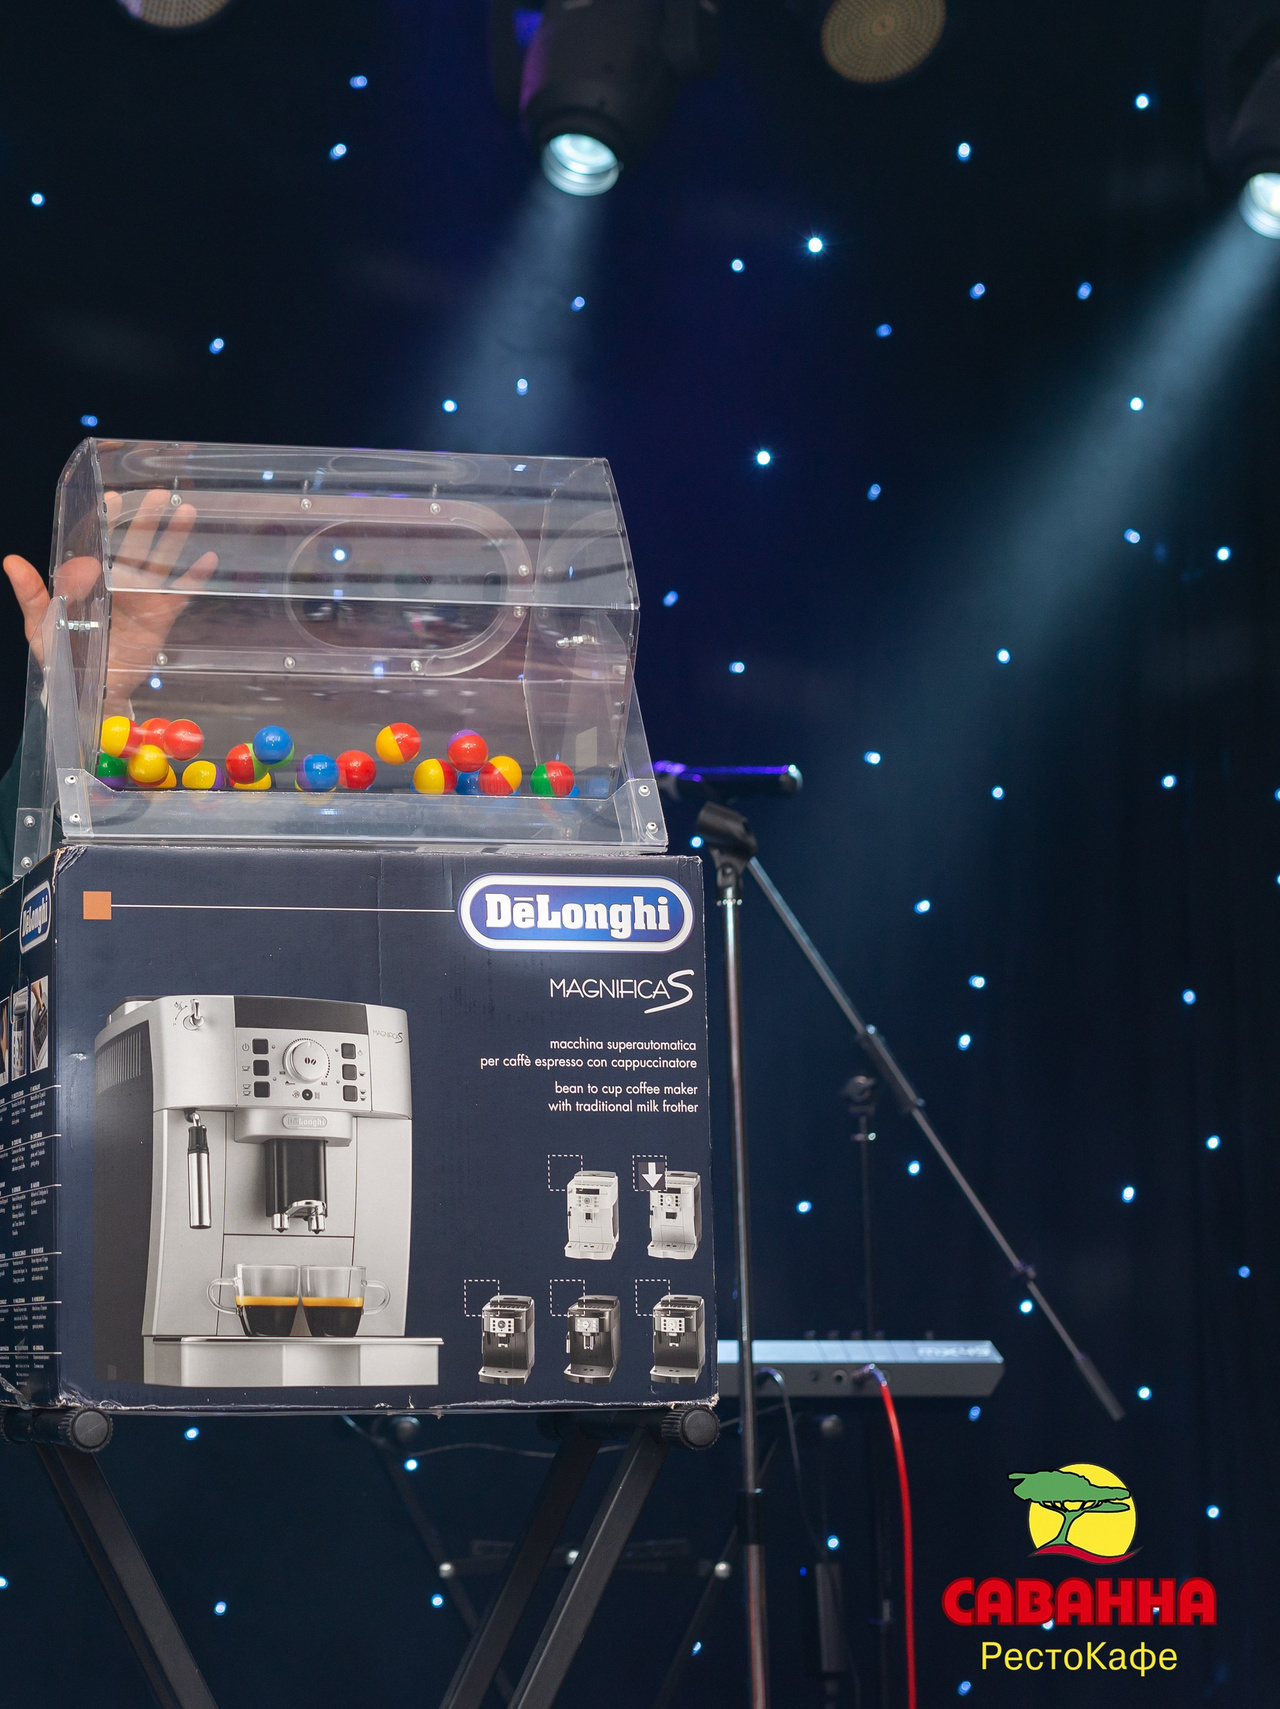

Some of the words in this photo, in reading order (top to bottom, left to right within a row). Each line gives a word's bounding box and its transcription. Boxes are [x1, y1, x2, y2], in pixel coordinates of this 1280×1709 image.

[549, 1036, 604, 1050] macchina
[606, 1039, 697, 1054] superautomatica
[480, 1056, 500, 1070] per
[502, 1053, 532, 1067] caffè
[534, 1057, 584, 1071] espresso
[586, 1057, 608, 1068] con
[610, 1056, 698, 1072] cappuccinatore
[554, 1080, 584, 1094] bean
[587, 1082, 599, 1094] to
[601, 1084, 623, 1098] cup
[625, 1080, 661, 1095] coffee
[663, 1081, 699, 1095] maker
[547, 1098, 572, 1112] with
[575, 1098, 633, 1113] traditional
[636, 1099, 660, 1113] milk
[662, 1099, 699, 1113] frother
